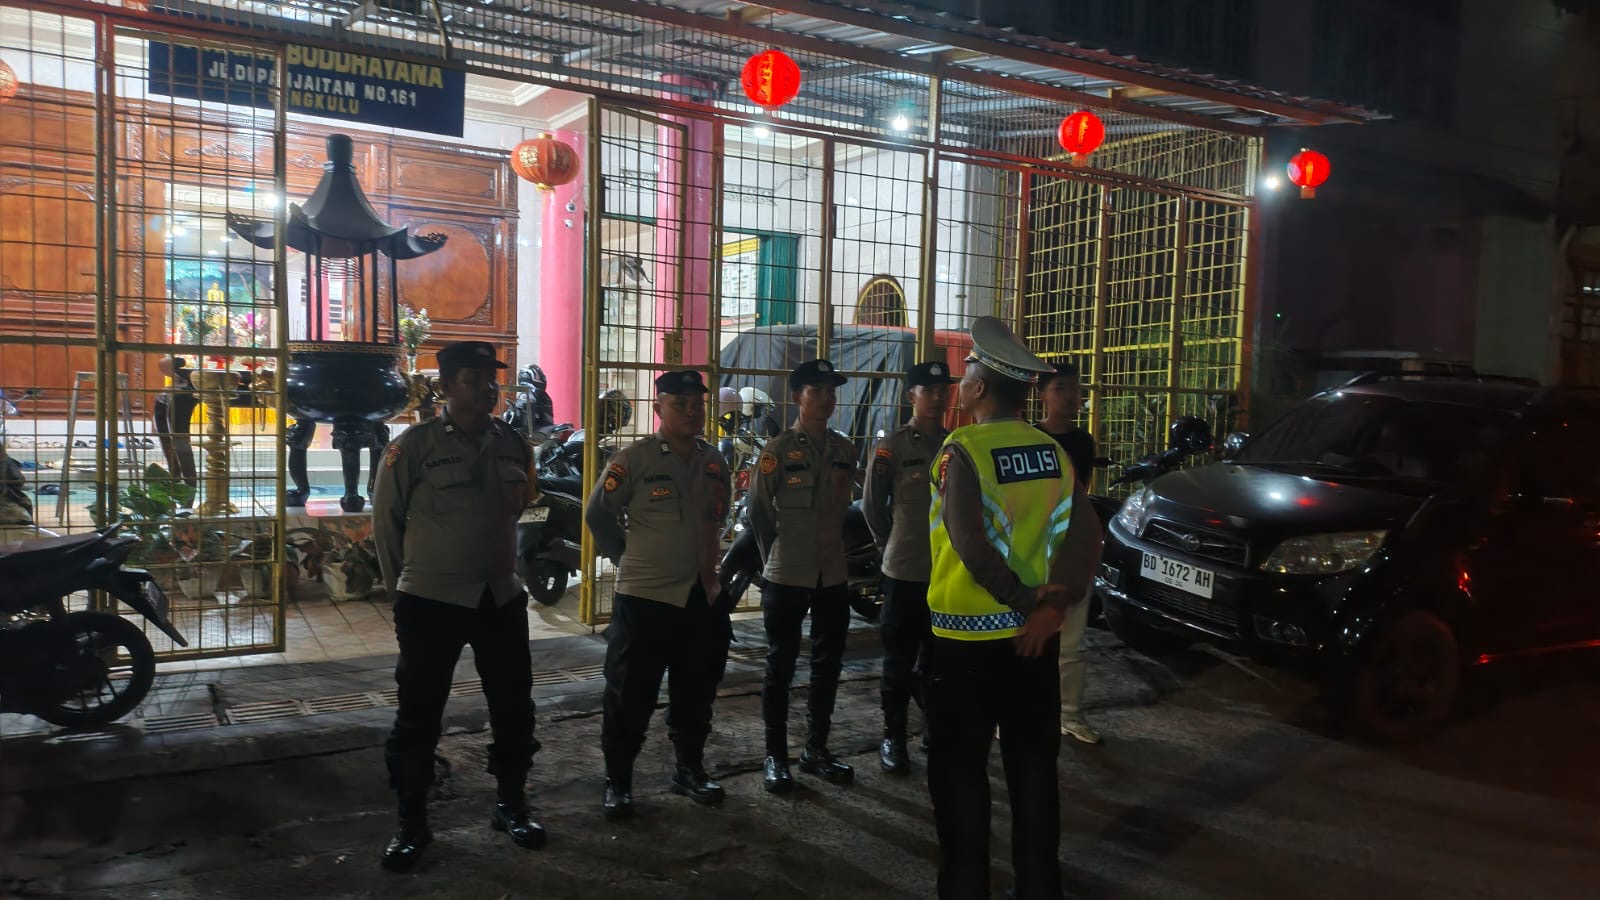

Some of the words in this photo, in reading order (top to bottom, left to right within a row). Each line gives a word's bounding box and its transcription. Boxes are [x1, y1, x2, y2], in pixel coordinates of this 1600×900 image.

[286, 43, 444, 89] BUDDHAYANA
[267, 86, 360, 115] BNGKULU
[364, 84, 417, 107] NO.161
[998, 450, 1059, 477] POLISI
[1143, 554, 1157, 570] BD
[1161, 560, 1190, 581] 1672
[1194, 570, 1211, 588] AH
